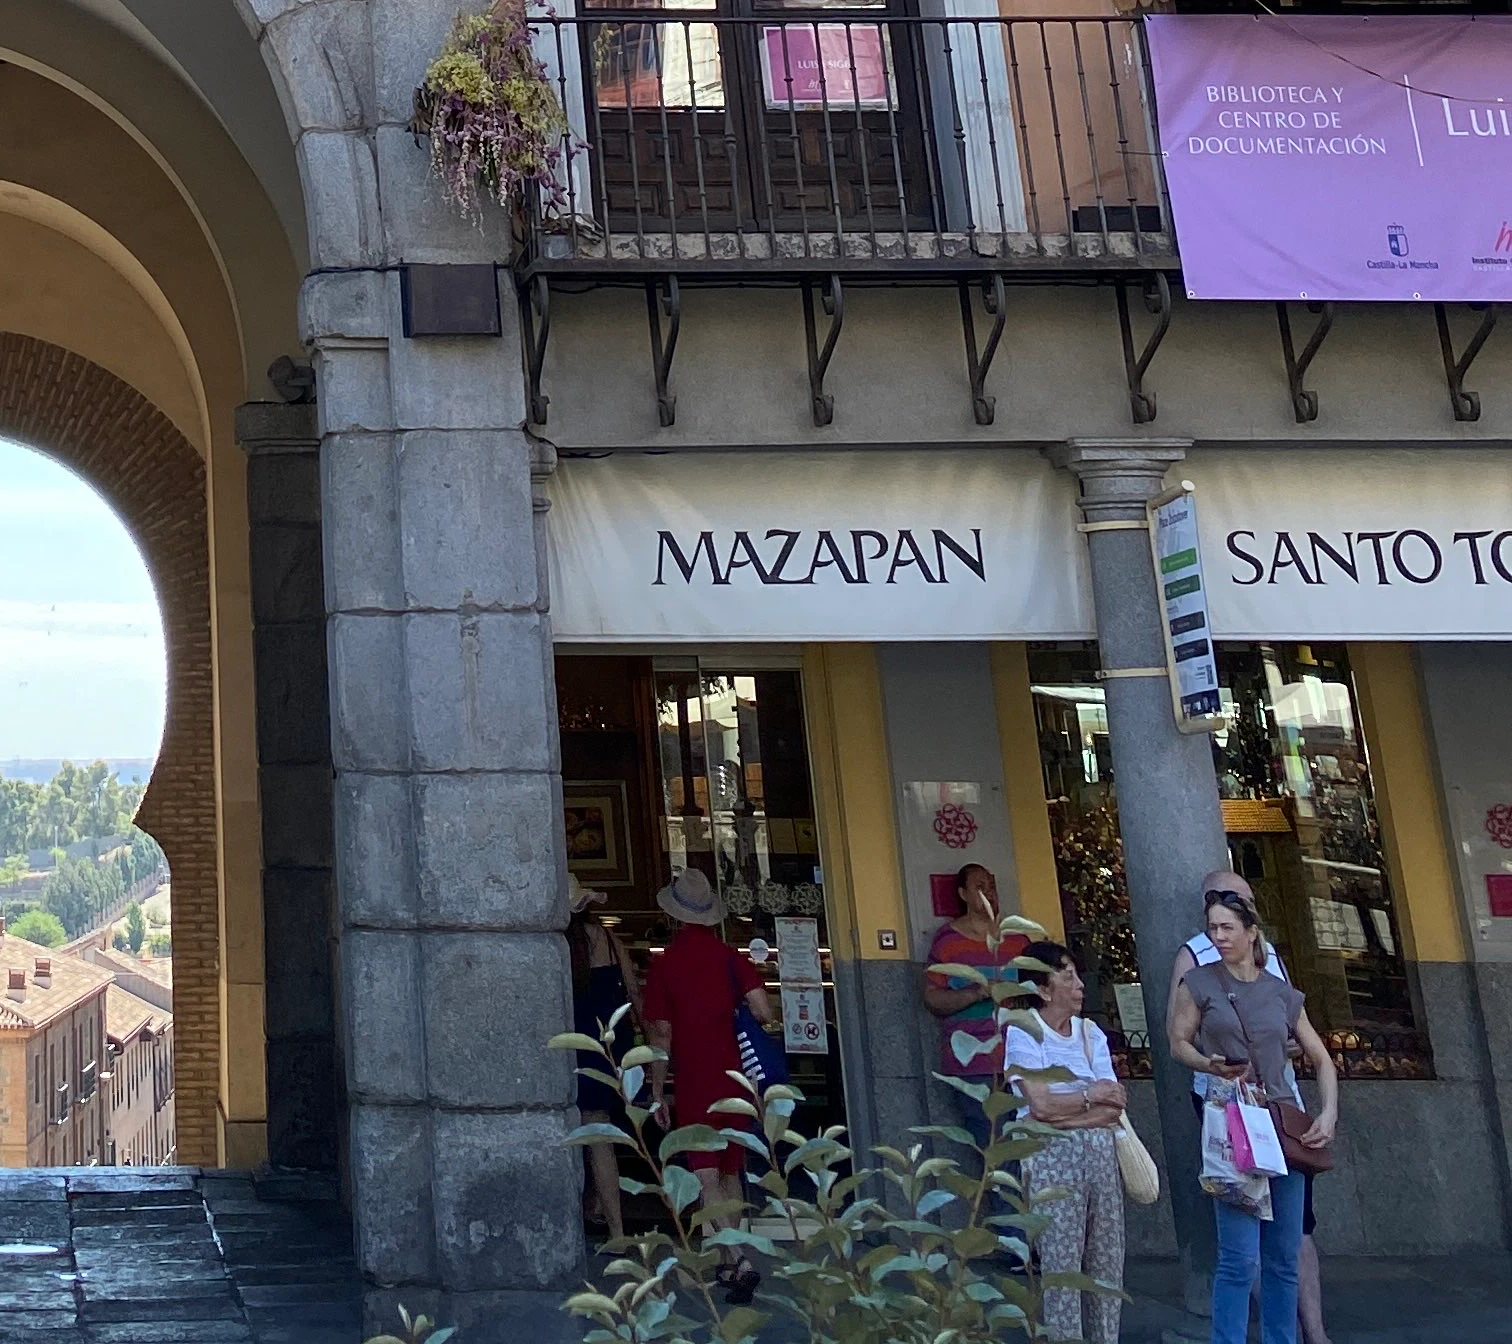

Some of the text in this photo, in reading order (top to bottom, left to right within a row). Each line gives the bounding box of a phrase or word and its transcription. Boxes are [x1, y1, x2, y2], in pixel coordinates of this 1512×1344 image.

[797, 60, 824, 69] LUIS
[1206, 86, 1344, 104] BIBLIOTECA Y
[1218, 111, 1343, 129] CENTRO DE
[1441, 98, 1511, 136] Lui
[1188, 133, 1387, 155] DOCUMENTACIÓN
[651, 528, 986, 585] MAZAPAN
[1226, 529, 1443, 585] SANTO
